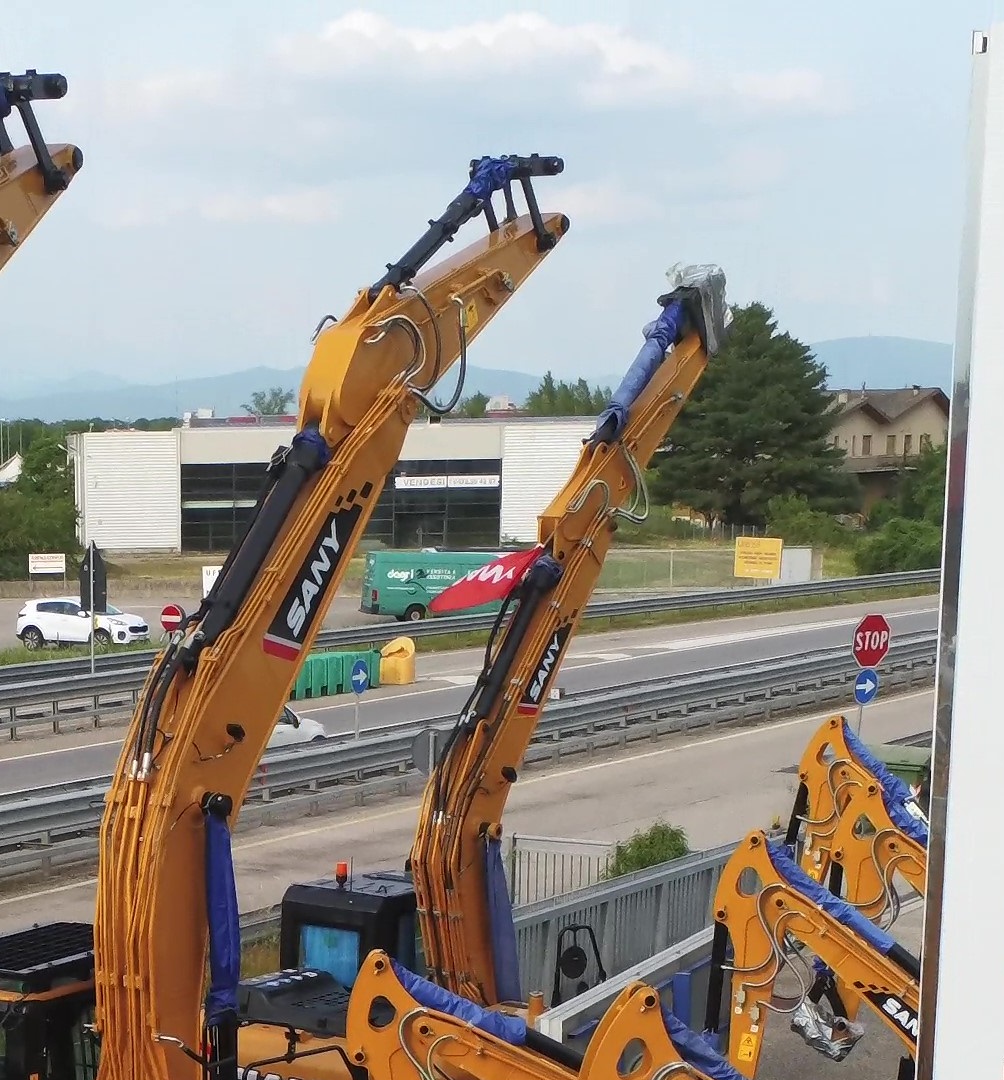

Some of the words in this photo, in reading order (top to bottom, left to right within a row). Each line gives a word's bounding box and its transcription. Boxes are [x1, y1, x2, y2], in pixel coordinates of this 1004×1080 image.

[286, 518, 340, 638] SANY
[529, 633, 560, 702] SANY
[855, 630, 888, 651] STOP
